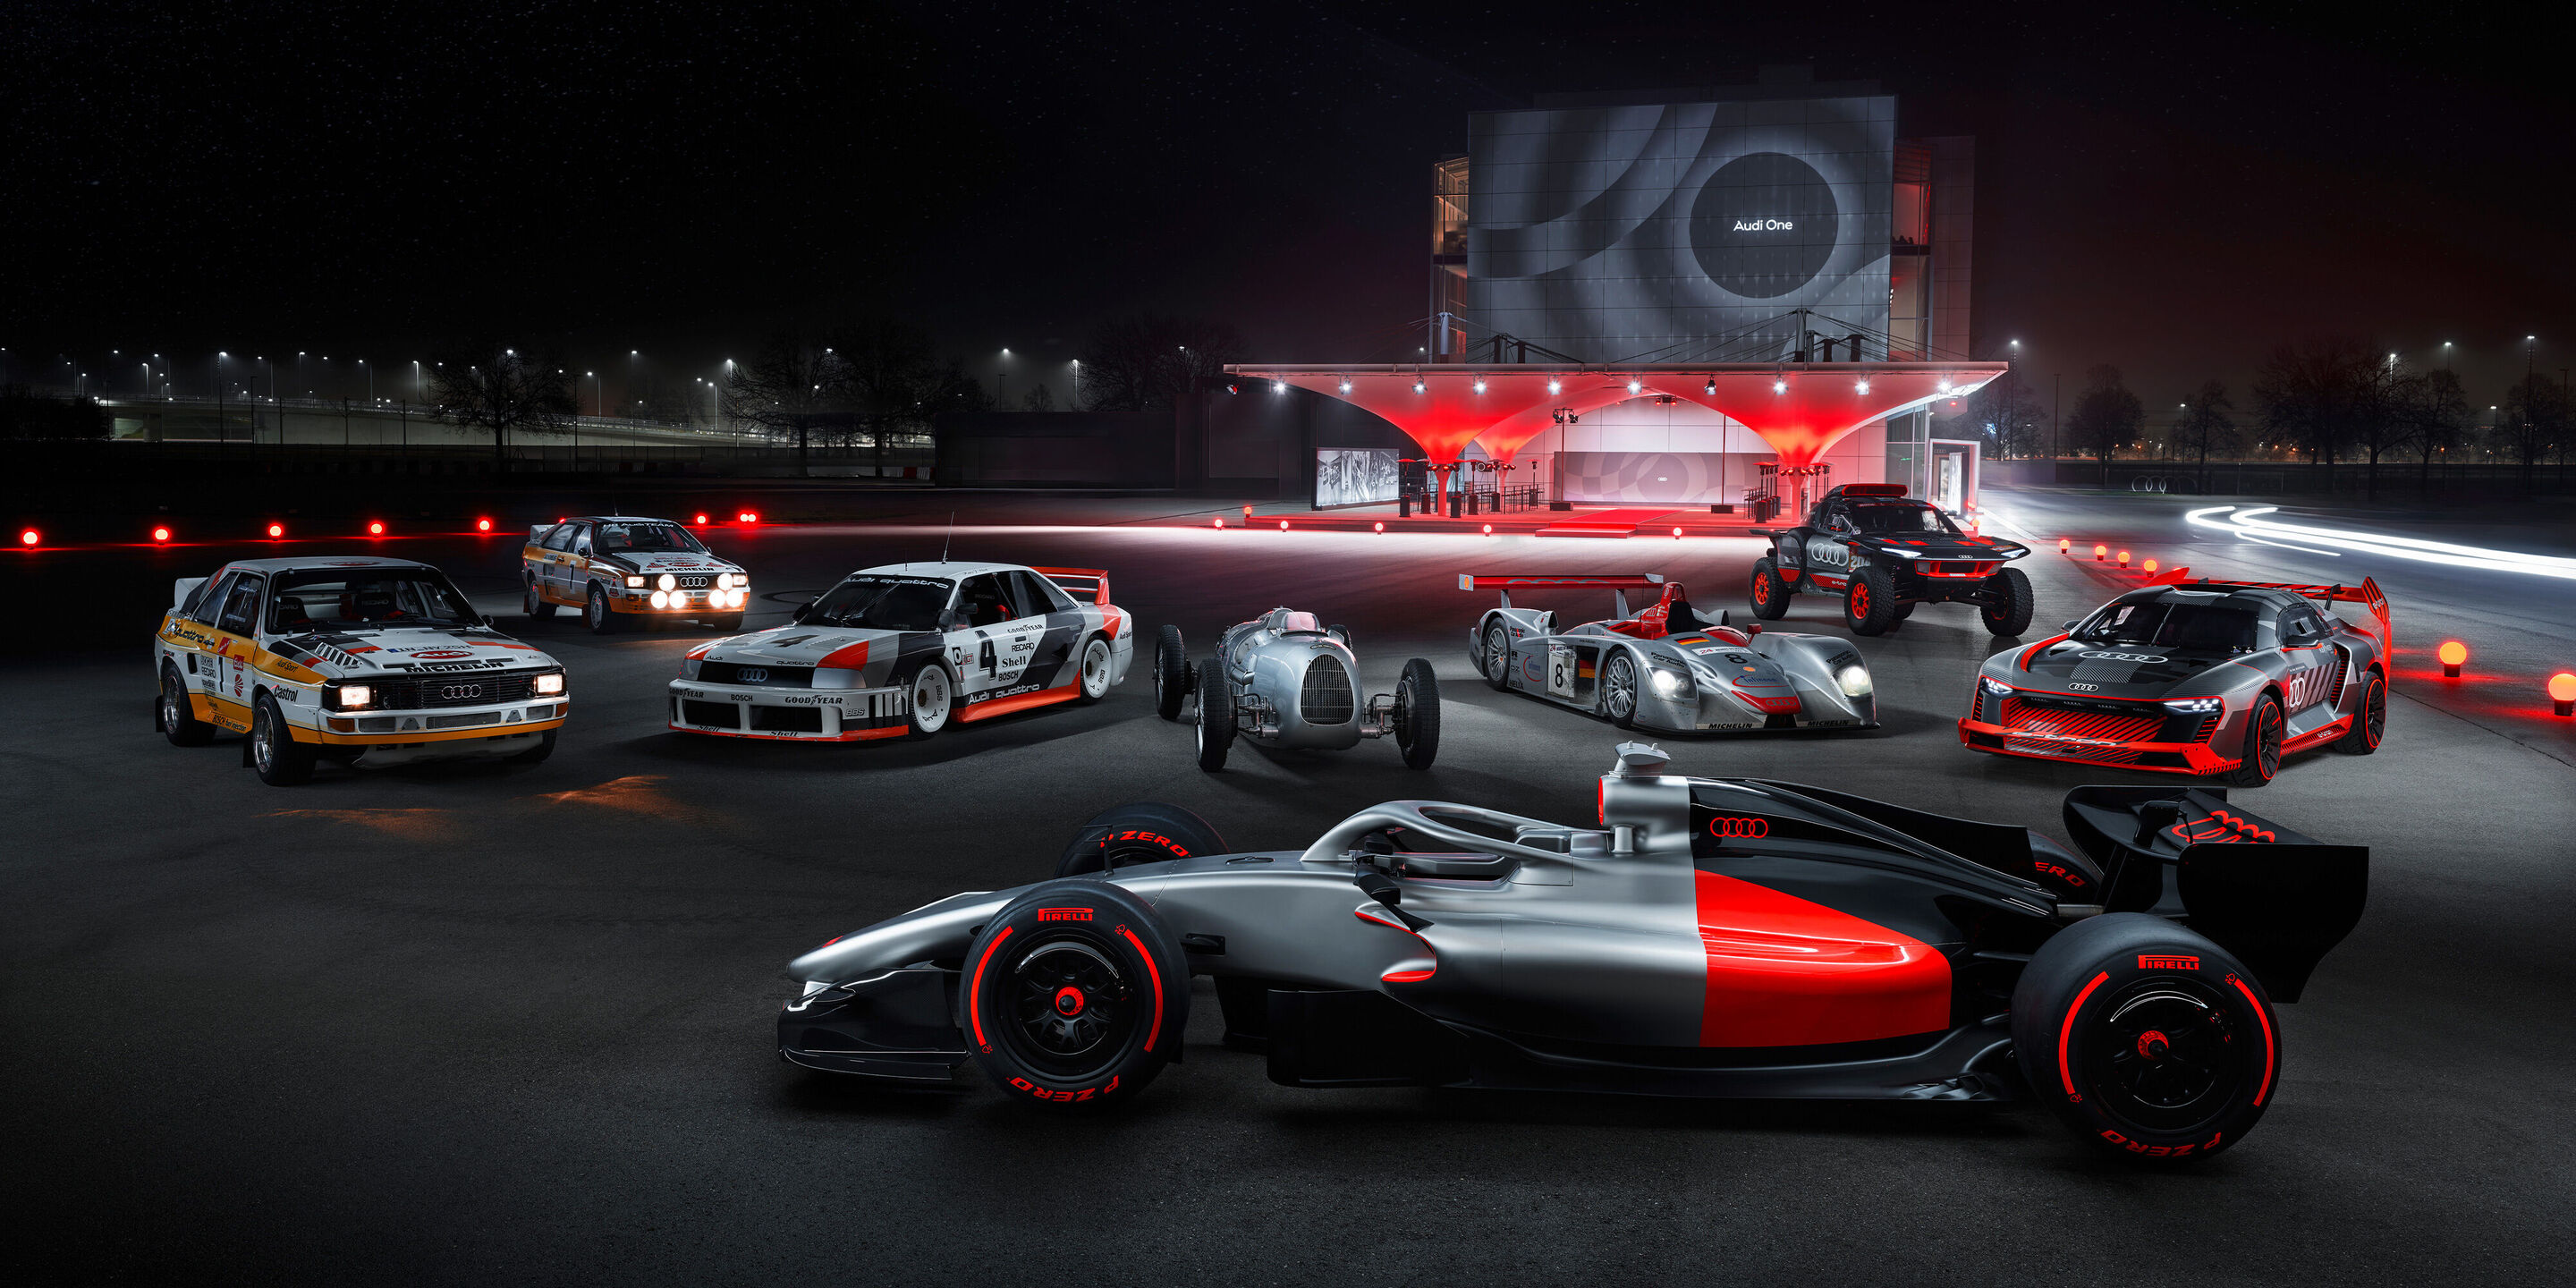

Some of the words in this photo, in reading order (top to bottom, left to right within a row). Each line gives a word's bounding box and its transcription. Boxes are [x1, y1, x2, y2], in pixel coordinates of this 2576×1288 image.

[1733, 219, 1764, 232] Audi
[1766, 218, 1793, 231] One
[880, 578, 949, 589] quattro
[769, 634, 820, 648] 4
[1011, 642, 1035, 652] RECARO
[974, 630, 997, 680] 4
[1002, 656, 1027, 668] Shell
[1650, 651, 1687, 665] Panasonic
[1724, 653, 1748, 664] 8
[403, 661, 505, 673] MICHELIN
[1665, 658, 1685, 668] Audio
[998, 670, 1019, 682] BOSCH
[1555, 663, 1563, 688] 8
[274, 684, 299, 702] Castrol
[731, 693, 753, 702] BOSCH
[784, 694, 843, 706] GOODYEAR
[968, 692, 990, 705] Audi
[996, 683, 1040, 699] quattro
[845, 708, 865, 716] BBS
[1119, 830, 1190, 857] ZERO
[2034, 861, 2087, 887] ERO
[1038, 907, 1094, 921] PIRELLI
[2138, 954, 2200, 970] PIRELLI
[1009, 1076, 1096, 1102] ZERO
[1103, 1074, 1119, 1094] P
[2100, 1130, 2196, 1157] ZERO
[2203, 1131, 2222, 1150] P
